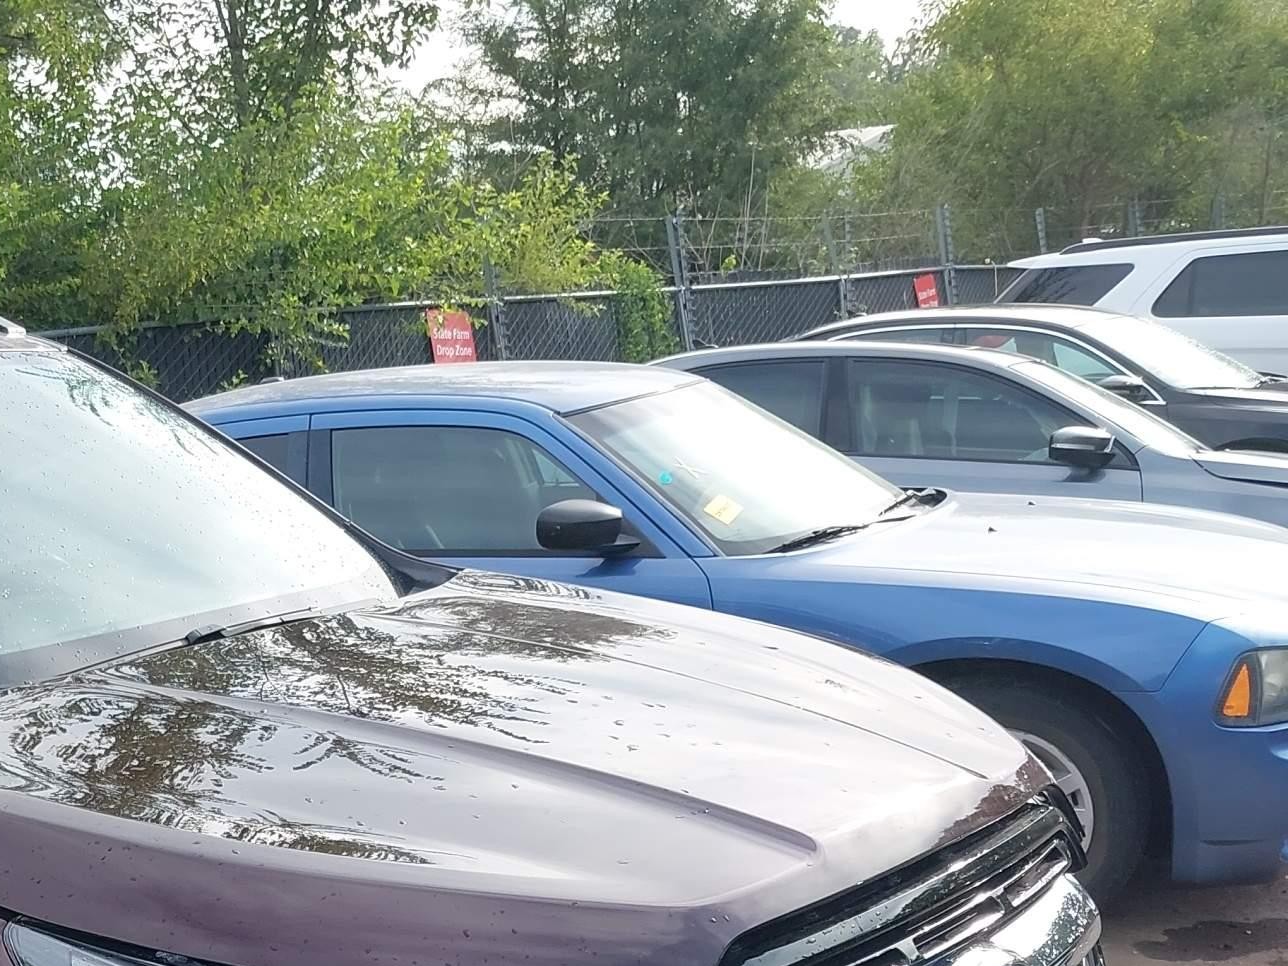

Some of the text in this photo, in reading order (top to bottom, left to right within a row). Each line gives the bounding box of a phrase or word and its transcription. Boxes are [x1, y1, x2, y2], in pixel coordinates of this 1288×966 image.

[433, 328, 470, 340] State Farm
[436, 344, 473, 358] Drop Zone
